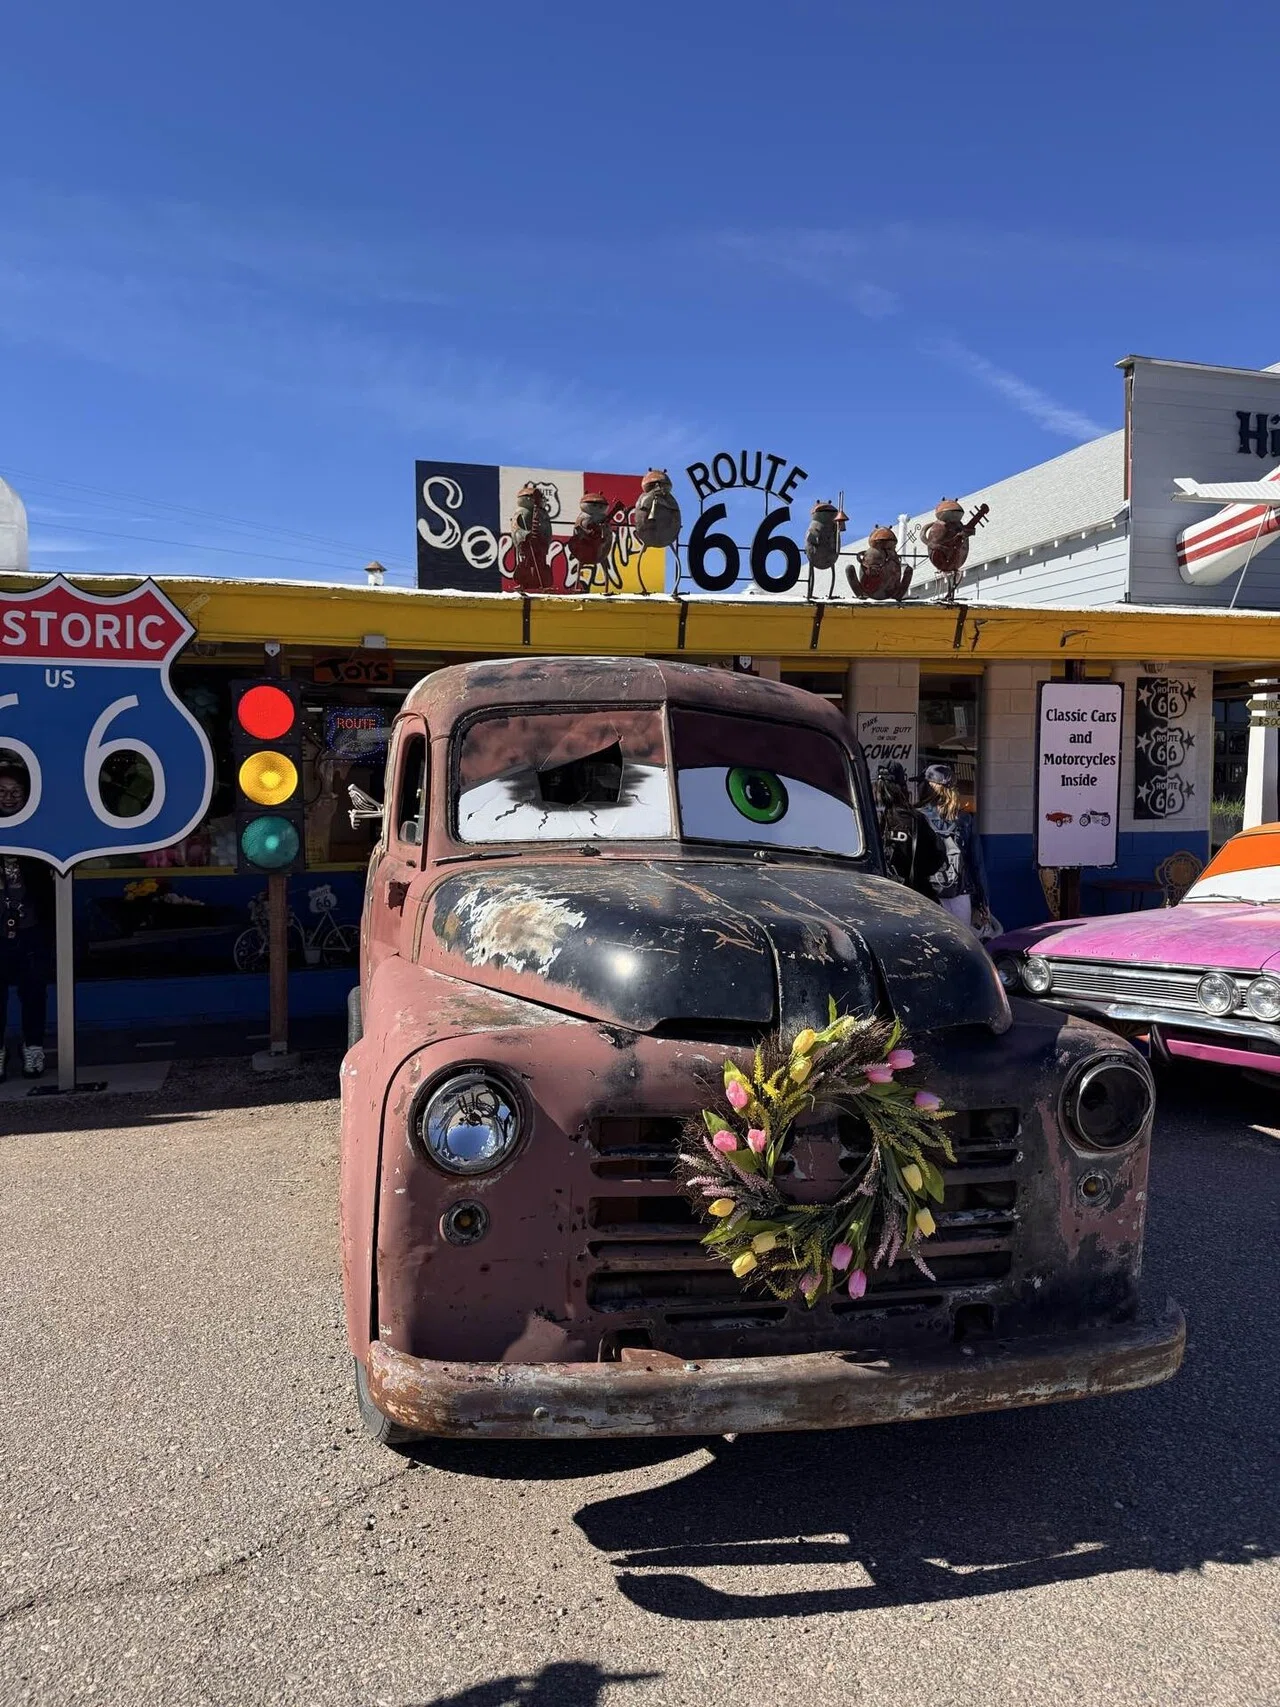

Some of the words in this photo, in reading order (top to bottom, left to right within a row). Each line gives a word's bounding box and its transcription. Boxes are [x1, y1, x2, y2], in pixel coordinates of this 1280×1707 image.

[686, 450, 809, 505] ROUTE
[687, 502, 802, 593] 66
[1, 610, 166, 650] STORIC
[45, 668, 76, 689] US
[1156, 685, 1180, 694] ROUTE
[1157, 696, 1178, 714] 66
[1046, 708, 1088, 722] Classic
[1091, 709, 1117, 723] Cars
[336, 717, 377, 730] ROUTE
[862, 716, 878, 731] PARK
[871, 726, 889, 734] YOUR
[893, 726, 912, 735] BUTT
[1069, 730, 1093, 744] and
[1156, 734, 1179, 743] ROUTE
[863, 743, 913, 760] COWCH
[1157, 745, 1178, 761] 66
[1043, 752, 1117, 768] Motorcycles
[1060, 773, 1098, 787] Inside
[1155, 781, 1178, 790] ROUTE
[1155, 792, 1176, 809] 66
